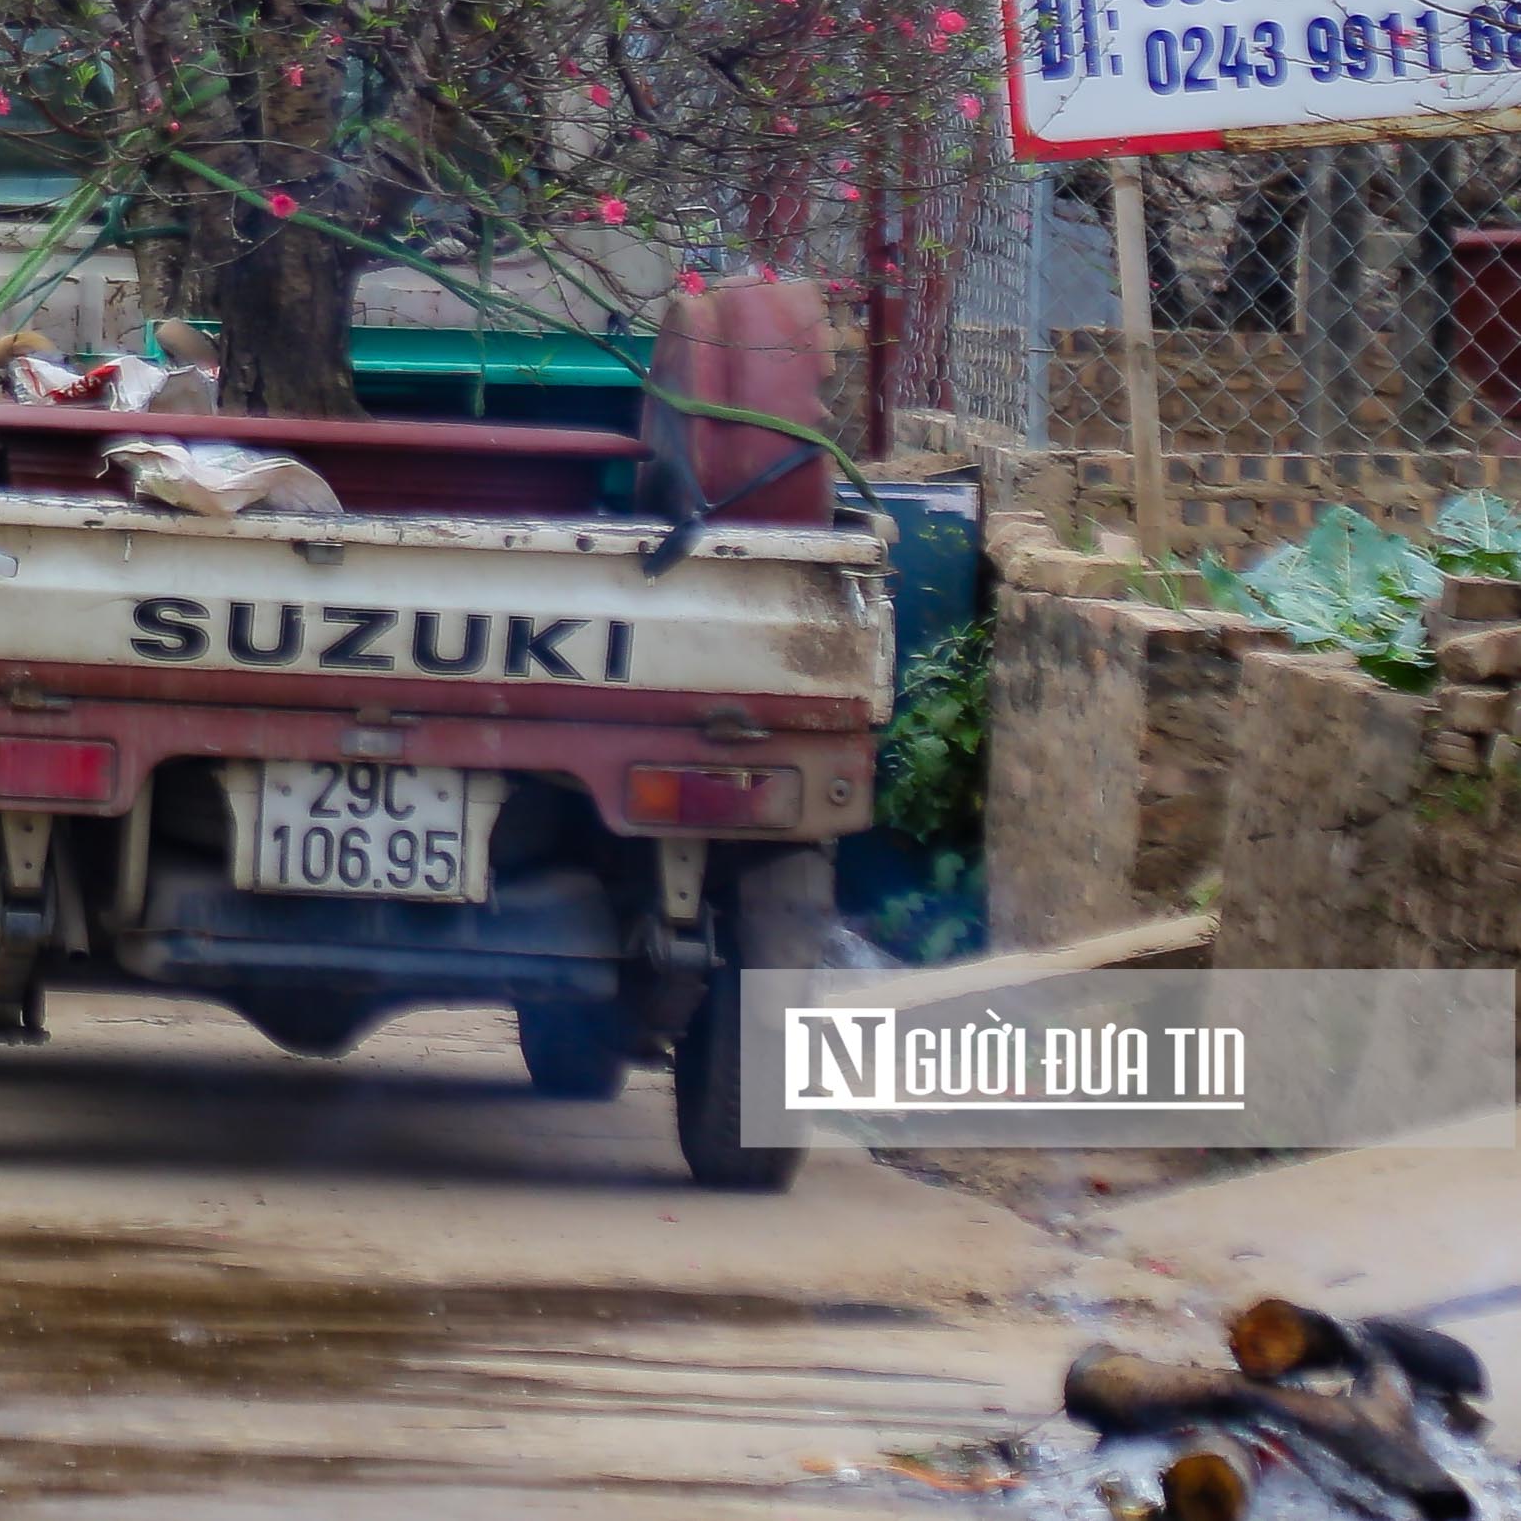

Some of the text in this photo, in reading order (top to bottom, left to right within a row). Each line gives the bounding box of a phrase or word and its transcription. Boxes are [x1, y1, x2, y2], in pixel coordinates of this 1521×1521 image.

[1144, 18, 1290, 96] 0243
[1306, 8, 1443, 85] 9911
[129, 596, 636, 684] SUZUKI
[308, 761, 419, 821] 29C
[272, 824, 460, 892] 106.95
